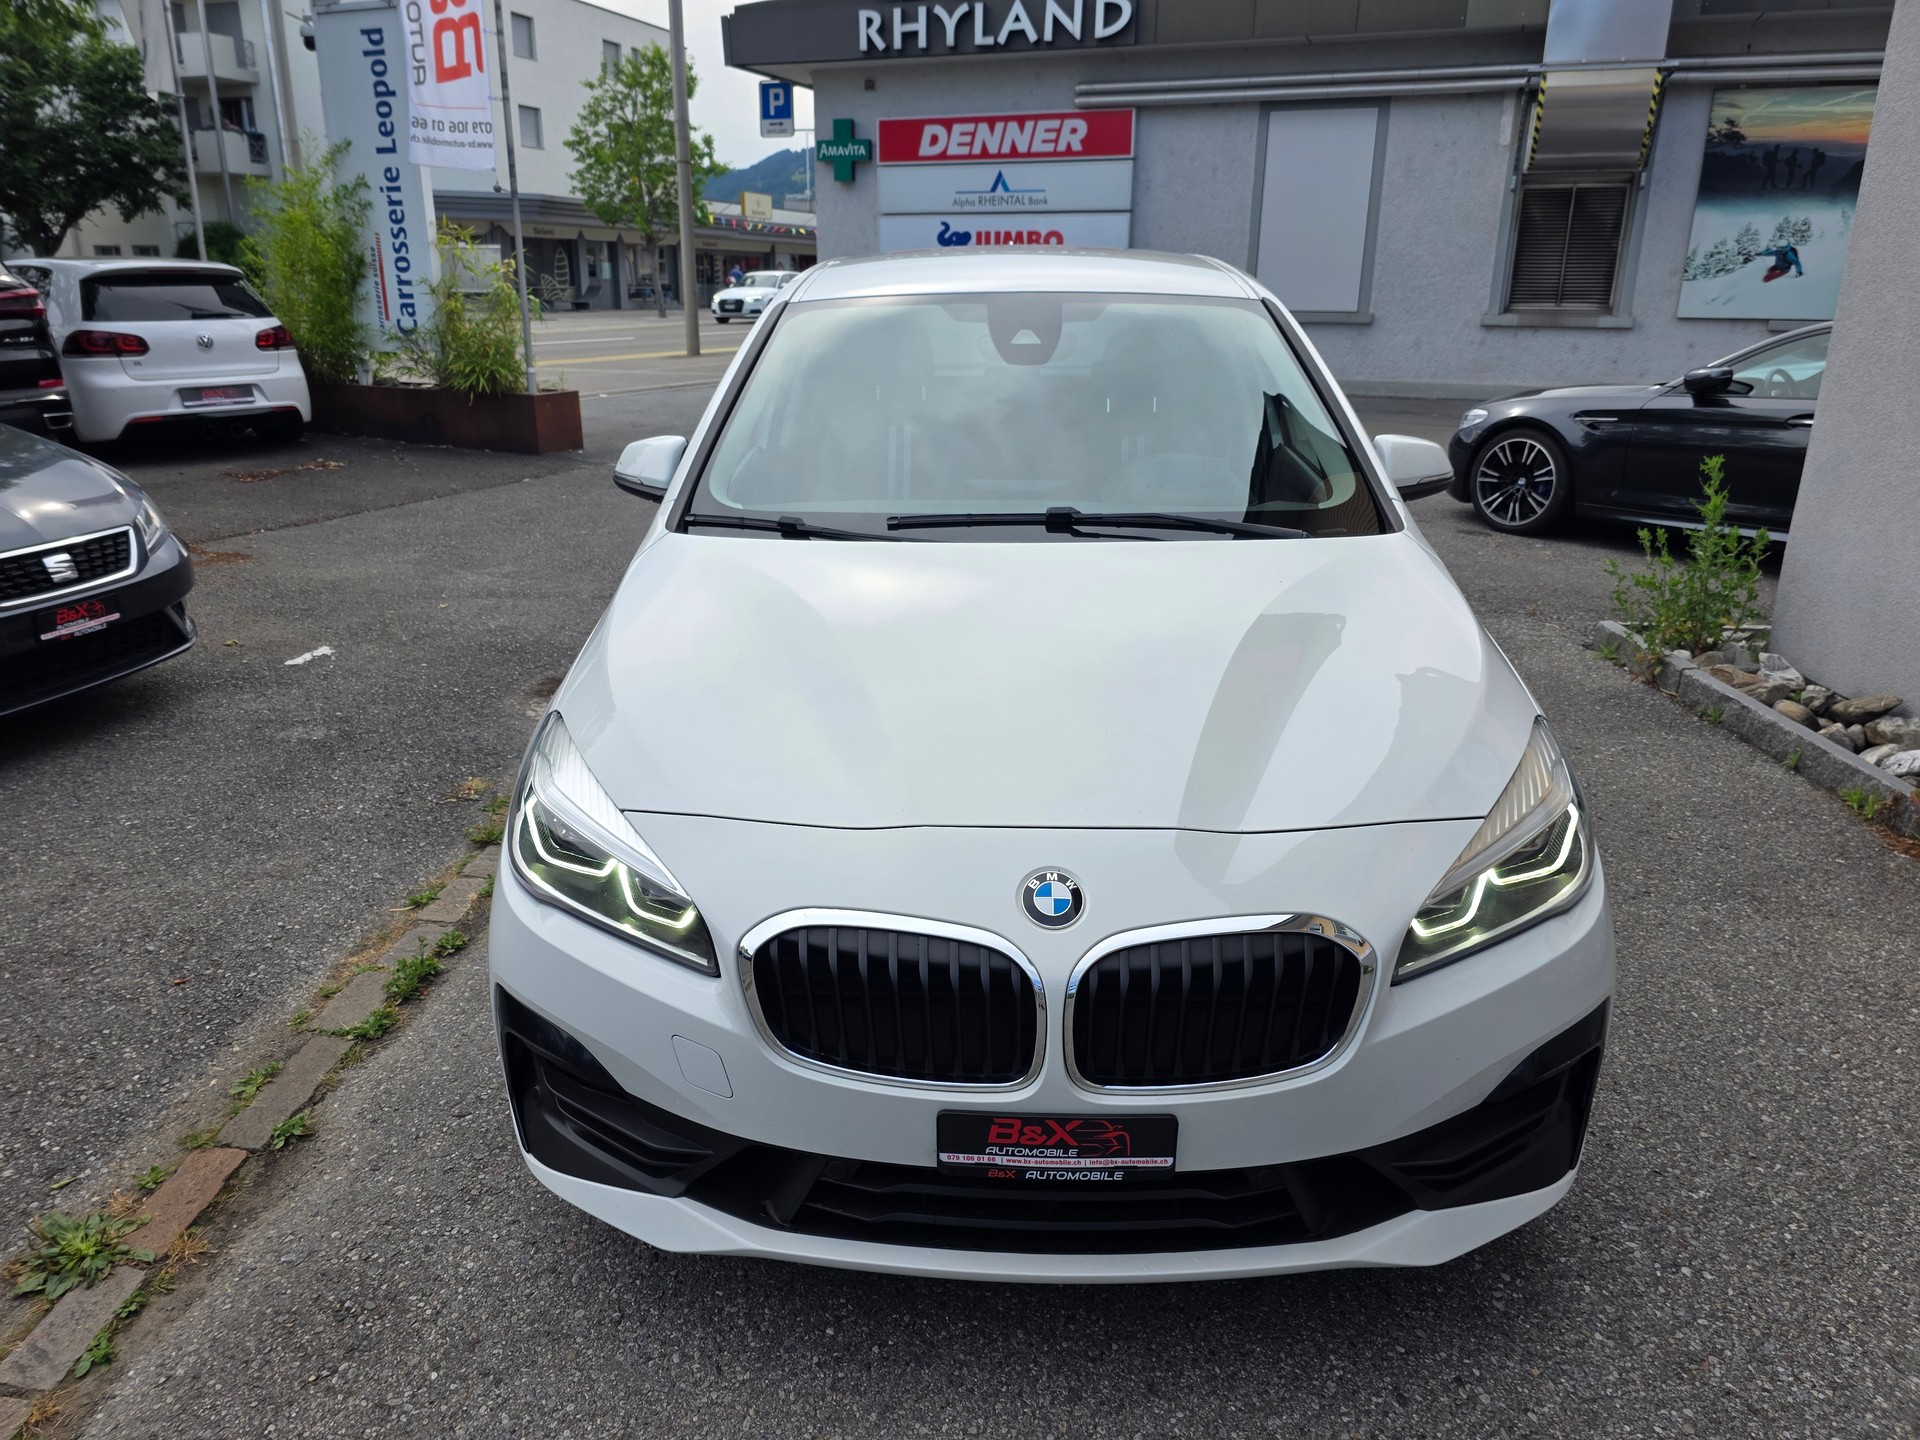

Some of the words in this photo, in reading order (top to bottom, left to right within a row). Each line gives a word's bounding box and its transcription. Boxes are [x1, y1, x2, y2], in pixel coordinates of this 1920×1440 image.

[858, 0, 1132, 52] RHYLAND
[360, 27, 397, 155] Leopold
[769, 87, 785, 116] P
[918, 118, 1088, 157] DENNER
[952, 197, 976, 207] Alpha
[978, 195, 1026, 207] RHEINTAL
[1028, 196, 1048, 206] Bank
[368, 246, 379, 278] suisse
[380, 166, 418, 337] Carrosserie
[56, 603, 88, 624] B&X
[1028, 872, 1077, 890] BMW
[987, 1118, 1084, 1146] B&X
[985, 1146, 1079, 1157] AUTOMOBILE
[1006, 1157, 1082, 1165] www.bx-automobile.ch
[987, 1169, 1017, 1178] B&X
[1025, 1171, 1124, 1181] AUTOMOBILE
